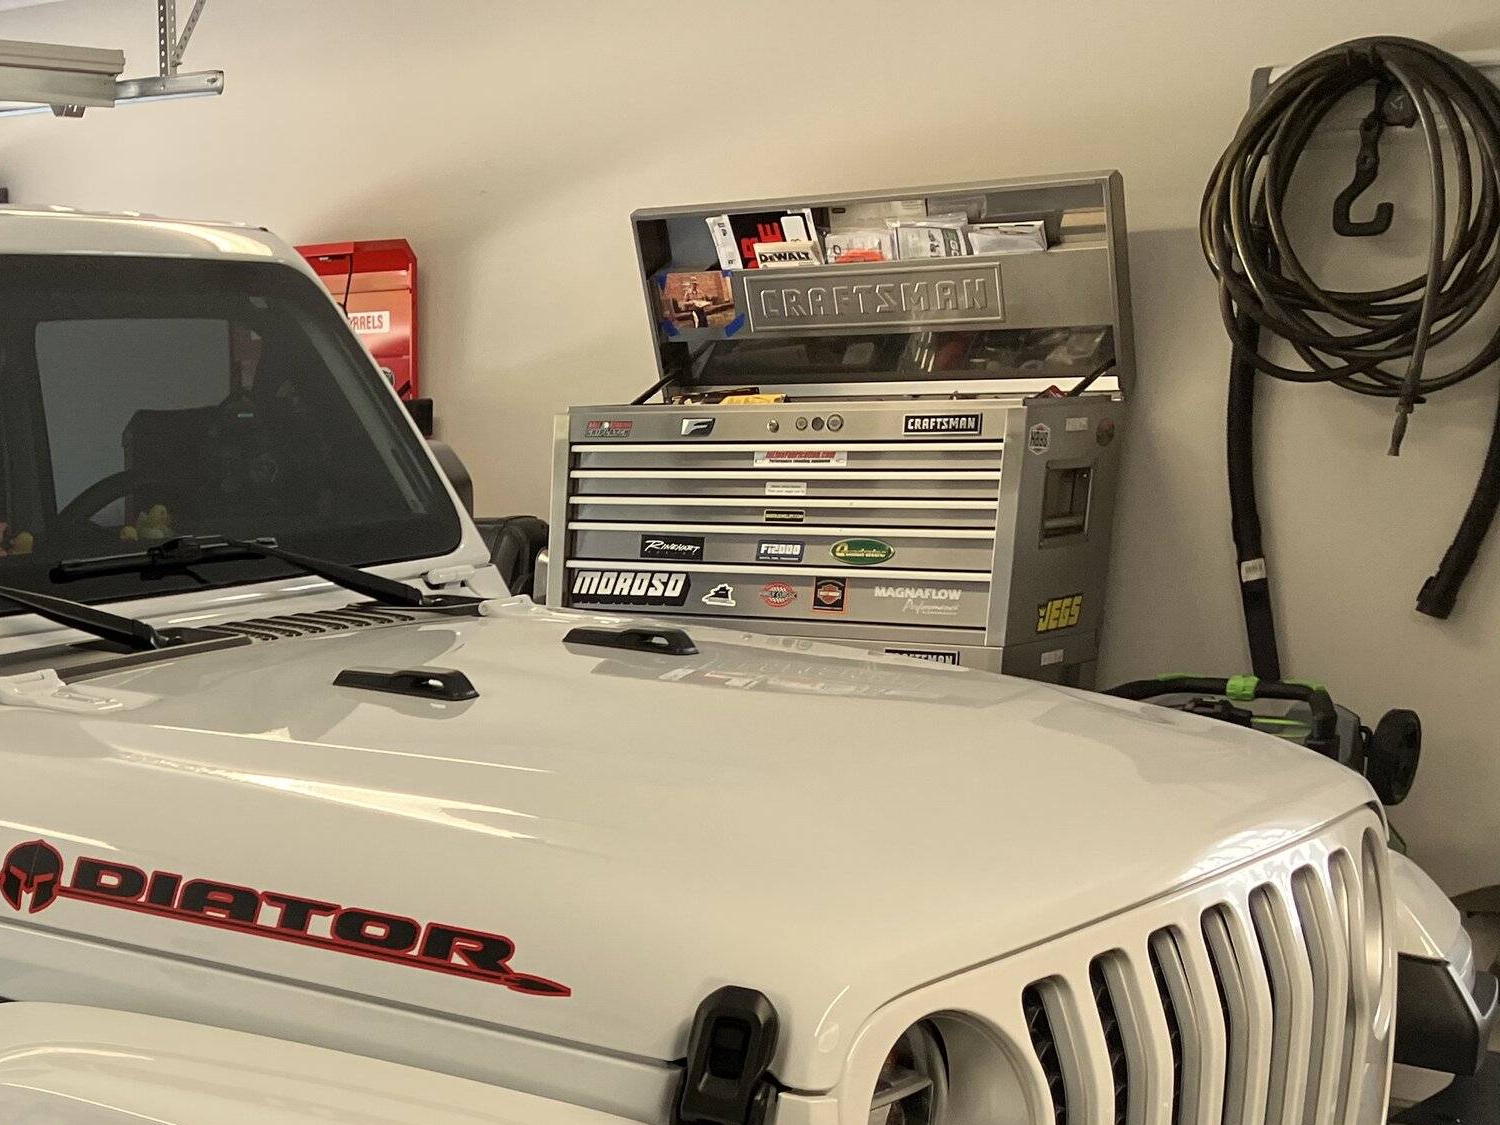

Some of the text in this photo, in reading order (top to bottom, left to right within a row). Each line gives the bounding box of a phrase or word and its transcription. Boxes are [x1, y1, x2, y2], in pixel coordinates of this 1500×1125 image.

[760, 278, 989, 318] CRAFTSMAN
[349, 314, 384, 331] RRELS
[906, 417, 977, 431] CRAFTSMAN
[572, 571, 687, 597] MOROSO
[874, 586, 963, 600] MAGNAFLOW
[1037, 595, 1084, 632] JEGS
